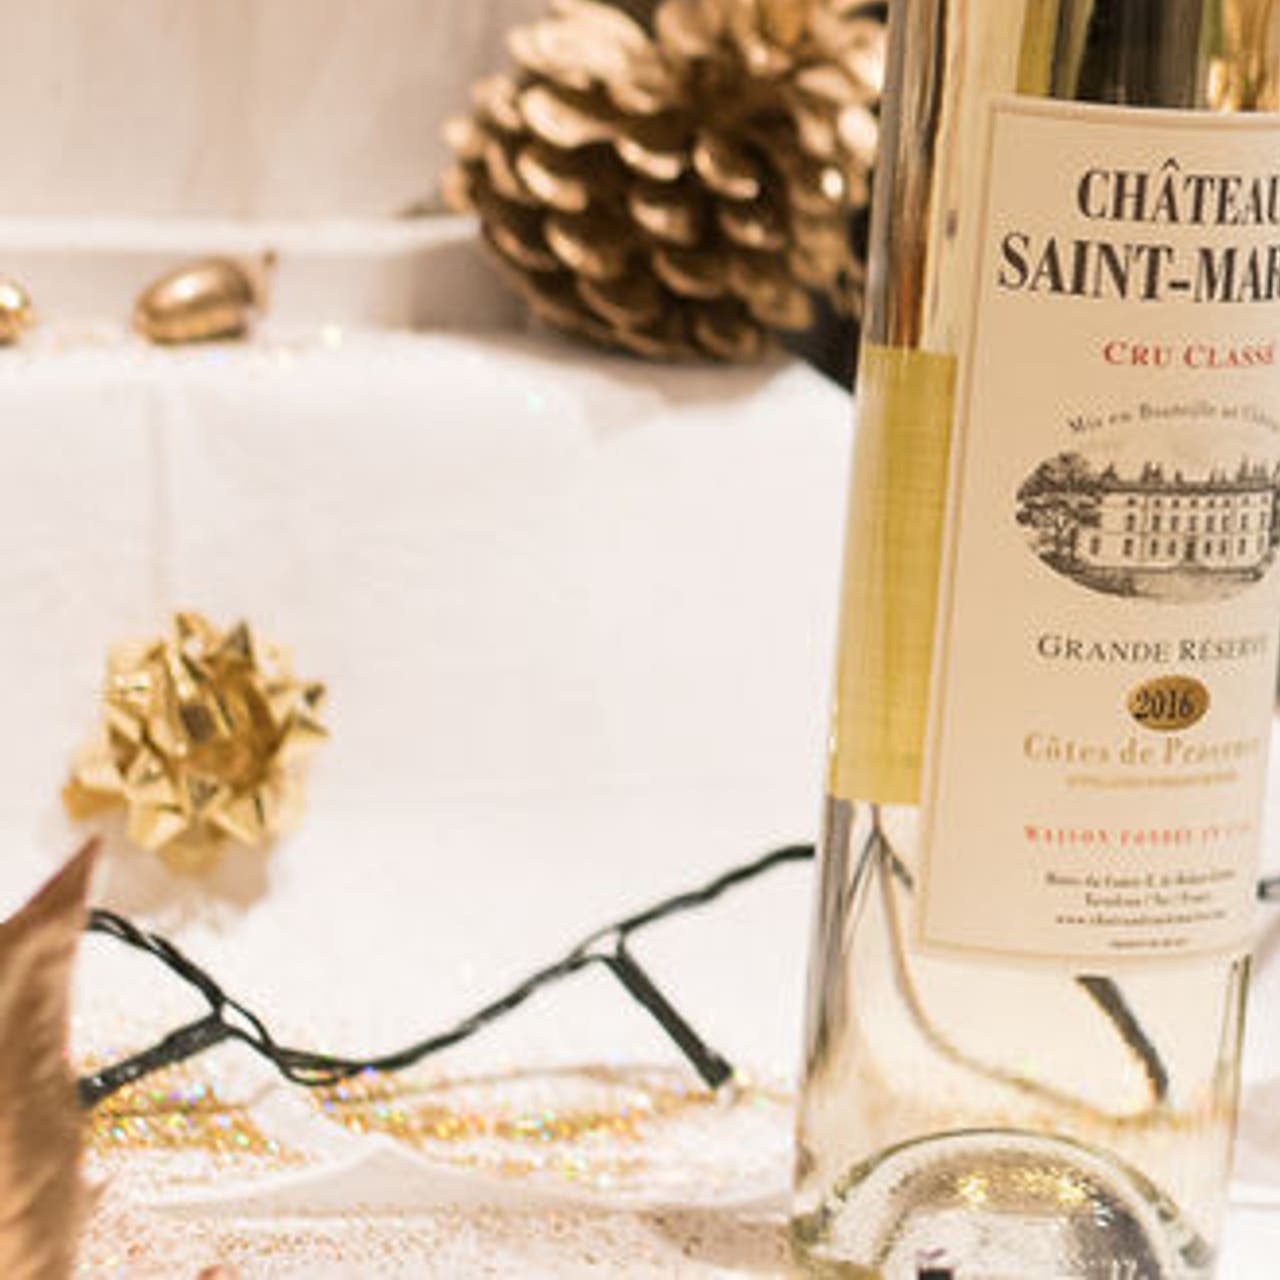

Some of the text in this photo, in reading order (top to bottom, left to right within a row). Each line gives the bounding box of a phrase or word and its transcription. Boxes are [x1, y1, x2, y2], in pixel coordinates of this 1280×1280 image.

[1104, 340, 1173, 367] CRU
[1037, 633, 1170, 663] GRANDE
[1133, 688, 1196, 721] 2016
[1023, 732, 1110, 763] Côtes
[1119, 735, 1155, 765] de
